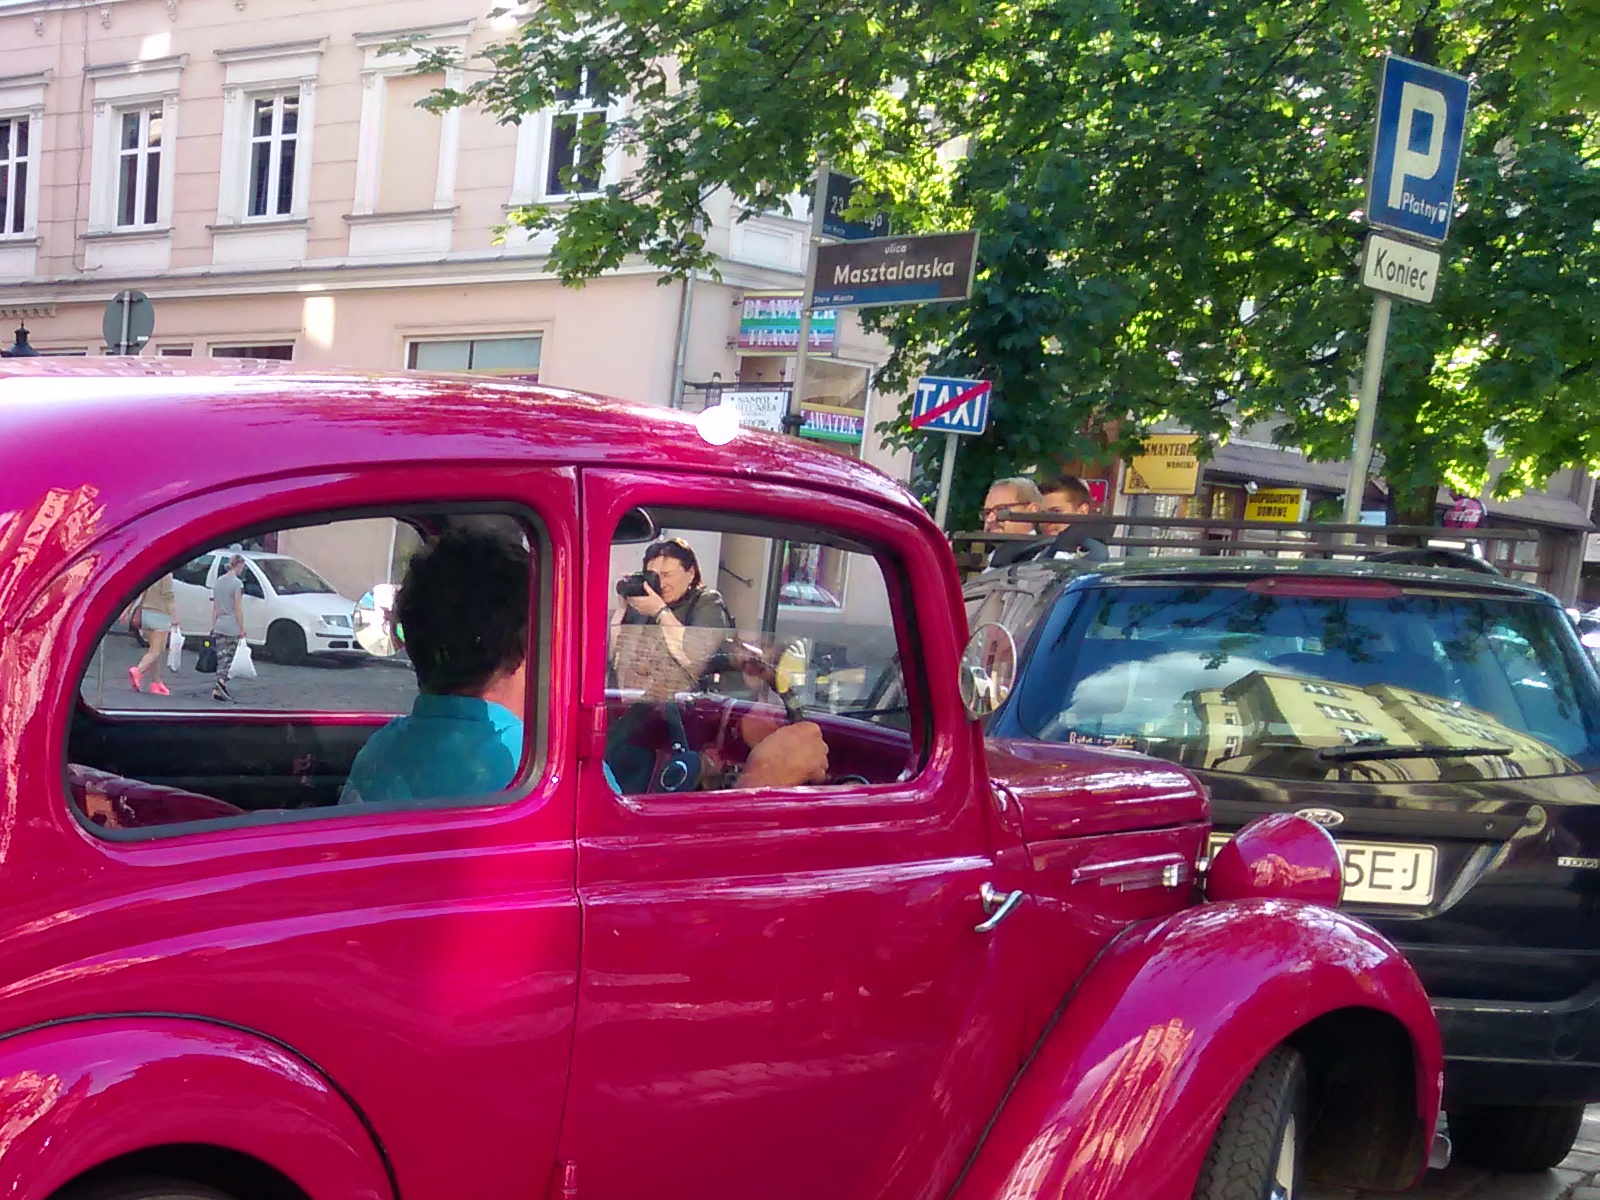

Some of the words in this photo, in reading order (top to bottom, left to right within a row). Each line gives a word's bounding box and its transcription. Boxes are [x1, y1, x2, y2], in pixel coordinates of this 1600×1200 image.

[1388, 81, 1447, 209] P
[1402, 192, 1439, 224] Płatny
[884, 243, 907, 254] ulica
[1373, 248, 1429, 291] Koniec
[834, 257, 955, 285] Masztalarska
[918, 383, 985, 427] TAXI
[1344, 848, 1421, 892] 5EJ
